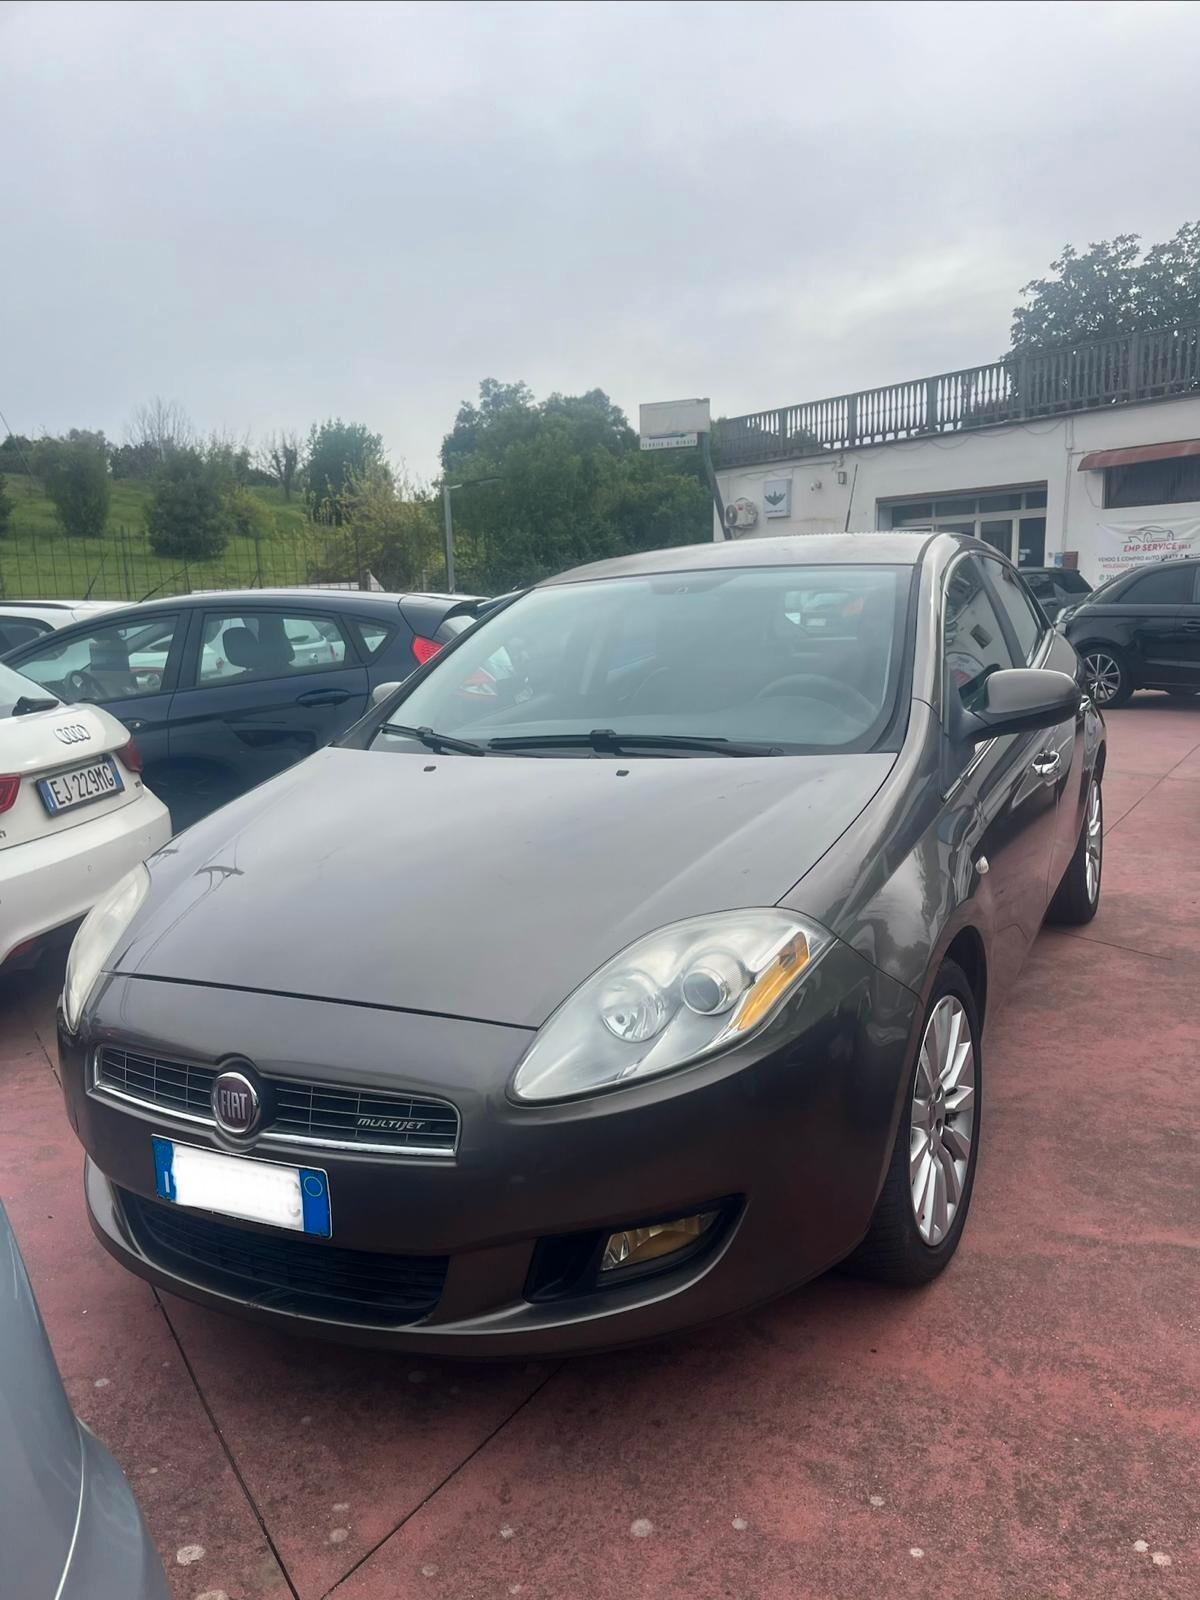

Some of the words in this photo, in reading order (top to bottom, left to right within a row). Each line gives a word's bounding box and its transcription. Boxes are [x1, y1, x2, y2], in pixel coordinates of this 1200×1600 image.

[1123, 544, 1141, 552] EMP
[1142, 542, 1177, 551] SERVICE
[50, 778, 73, 805] EJ
[73, 765, 114, 798] 229MG
[220, 1088, 249, 1121] FIAT
[357, 1117, 426, 1131] MULTIJET
